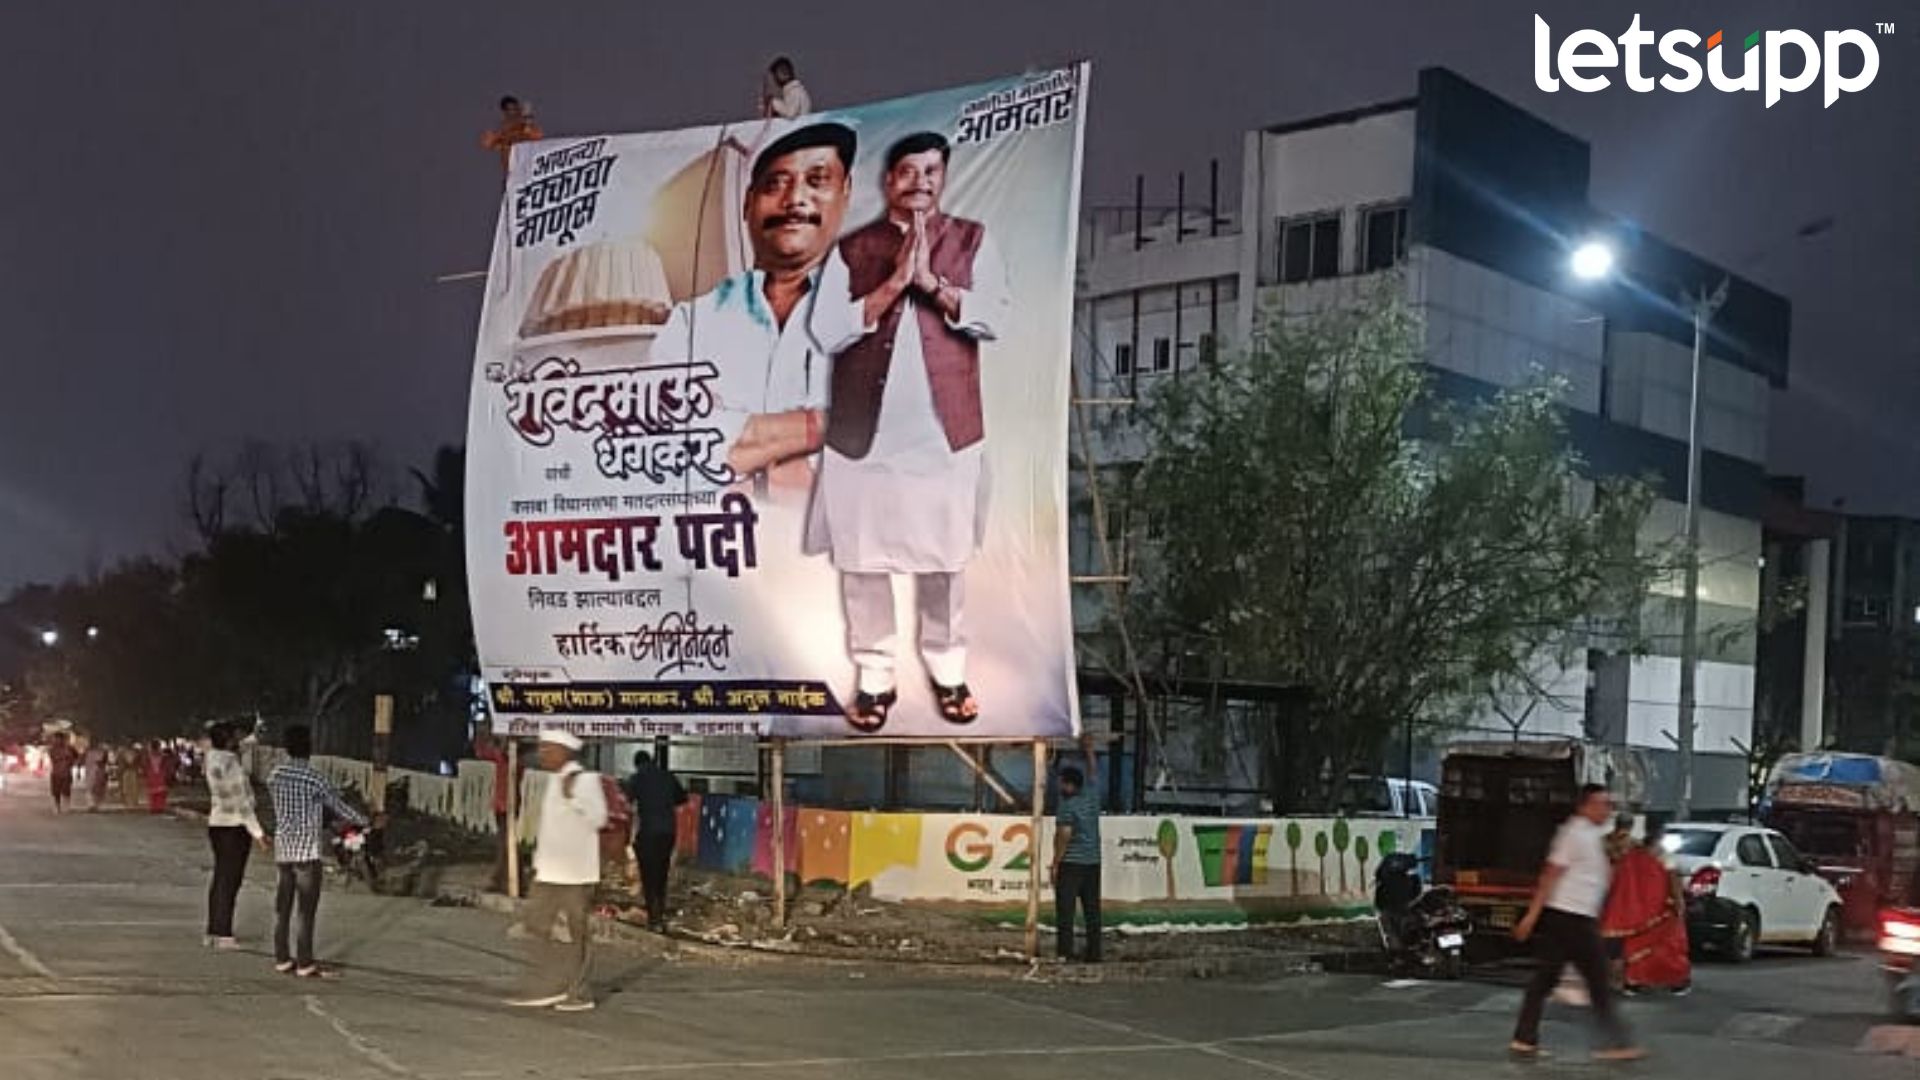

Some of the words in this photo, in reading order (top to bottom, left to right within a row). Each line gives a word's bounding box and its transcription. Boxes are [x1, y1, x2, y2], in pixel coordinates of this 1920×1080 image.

[957, 87, 1074, 143] आमदार
[533, 138, 607, 176] आपल्या
[516, 153, 619, 219] हक्काचा
[516, 190, 601, 247] माणूस
[504, 516, 662, 581] आमदार
[674, 492, 758, 577] पदी
[528, 586, 568, 609] निवड
[574, 588, 661, 609] झाल्याबद्दल
[552, 621, 625, 659] हार्दिक
[624, 609, 734, 680] अभिनंदन
